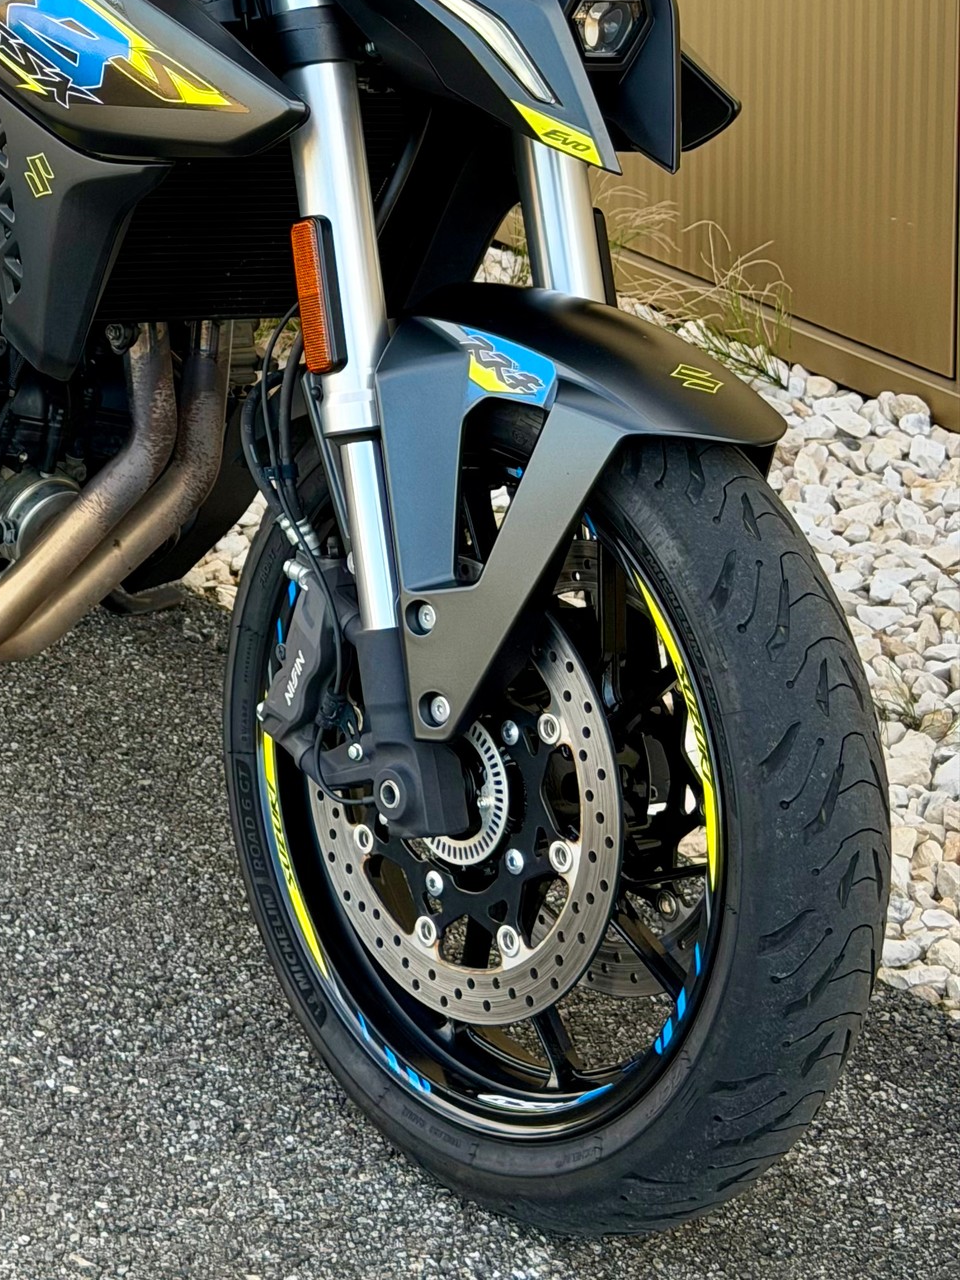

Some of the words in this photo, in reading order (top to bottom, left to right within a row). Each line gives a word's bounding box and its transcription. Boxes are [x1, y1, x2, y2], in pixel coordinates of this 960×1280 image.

[645, 552, 704, 662] MICHELIN
[675, 661, 712, 785] SUZUKI
[239, 770, 252, 794] GT
[241, 797, 252, 811] 6
[243, 815, 263, 871] ROAD
[262, 890, 309, 992] MICHELIN
